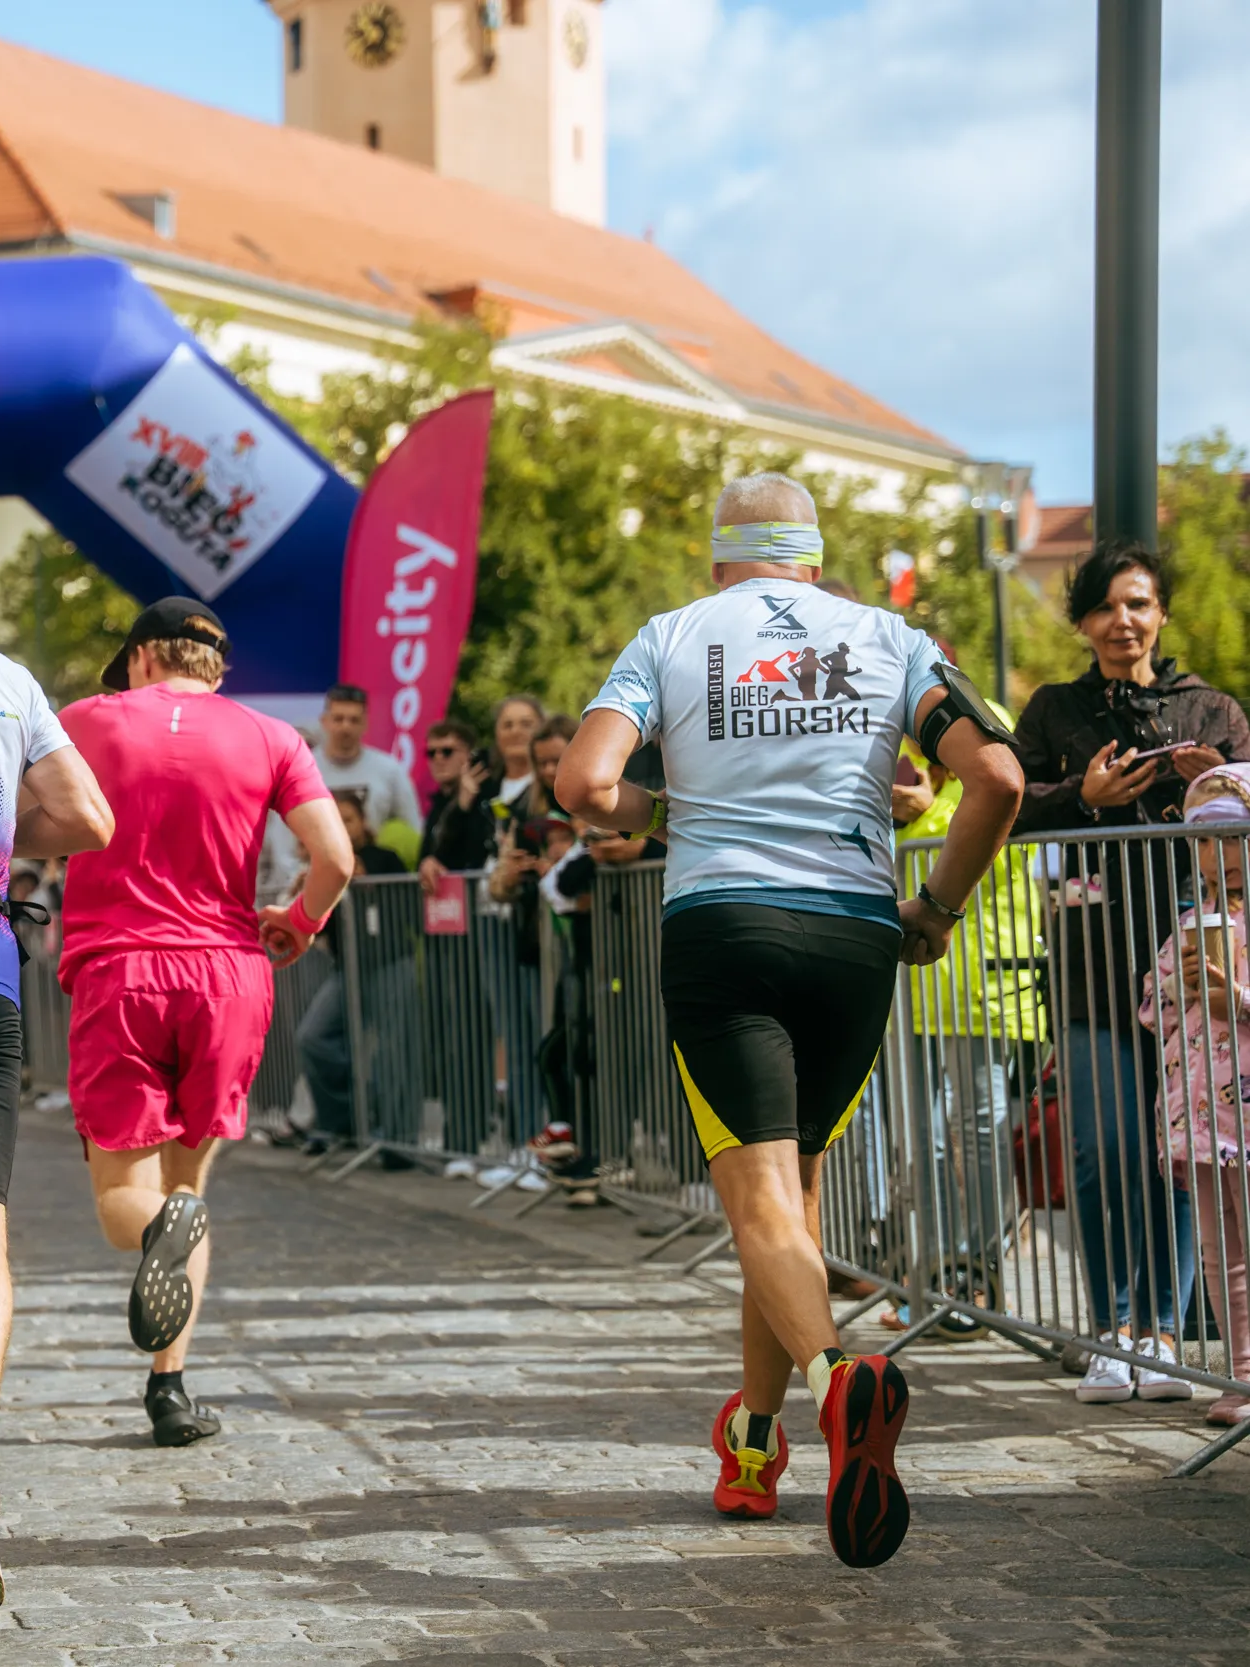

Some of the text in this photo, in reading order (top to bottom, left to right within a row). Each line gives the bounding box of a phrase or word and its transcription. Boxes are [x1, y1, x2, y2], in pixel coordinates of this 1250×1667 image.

[130, 415, 209, 472] XVIII
[147, 456, 243, 536] BIEG
[756, 631, 808, 640] SPAXOR
[709, 647, 723, 737] GŁUCHOŁASKI
[730, 685, 768, 707] BIEG
[731, 704, 869, 739] GÓRSKI
